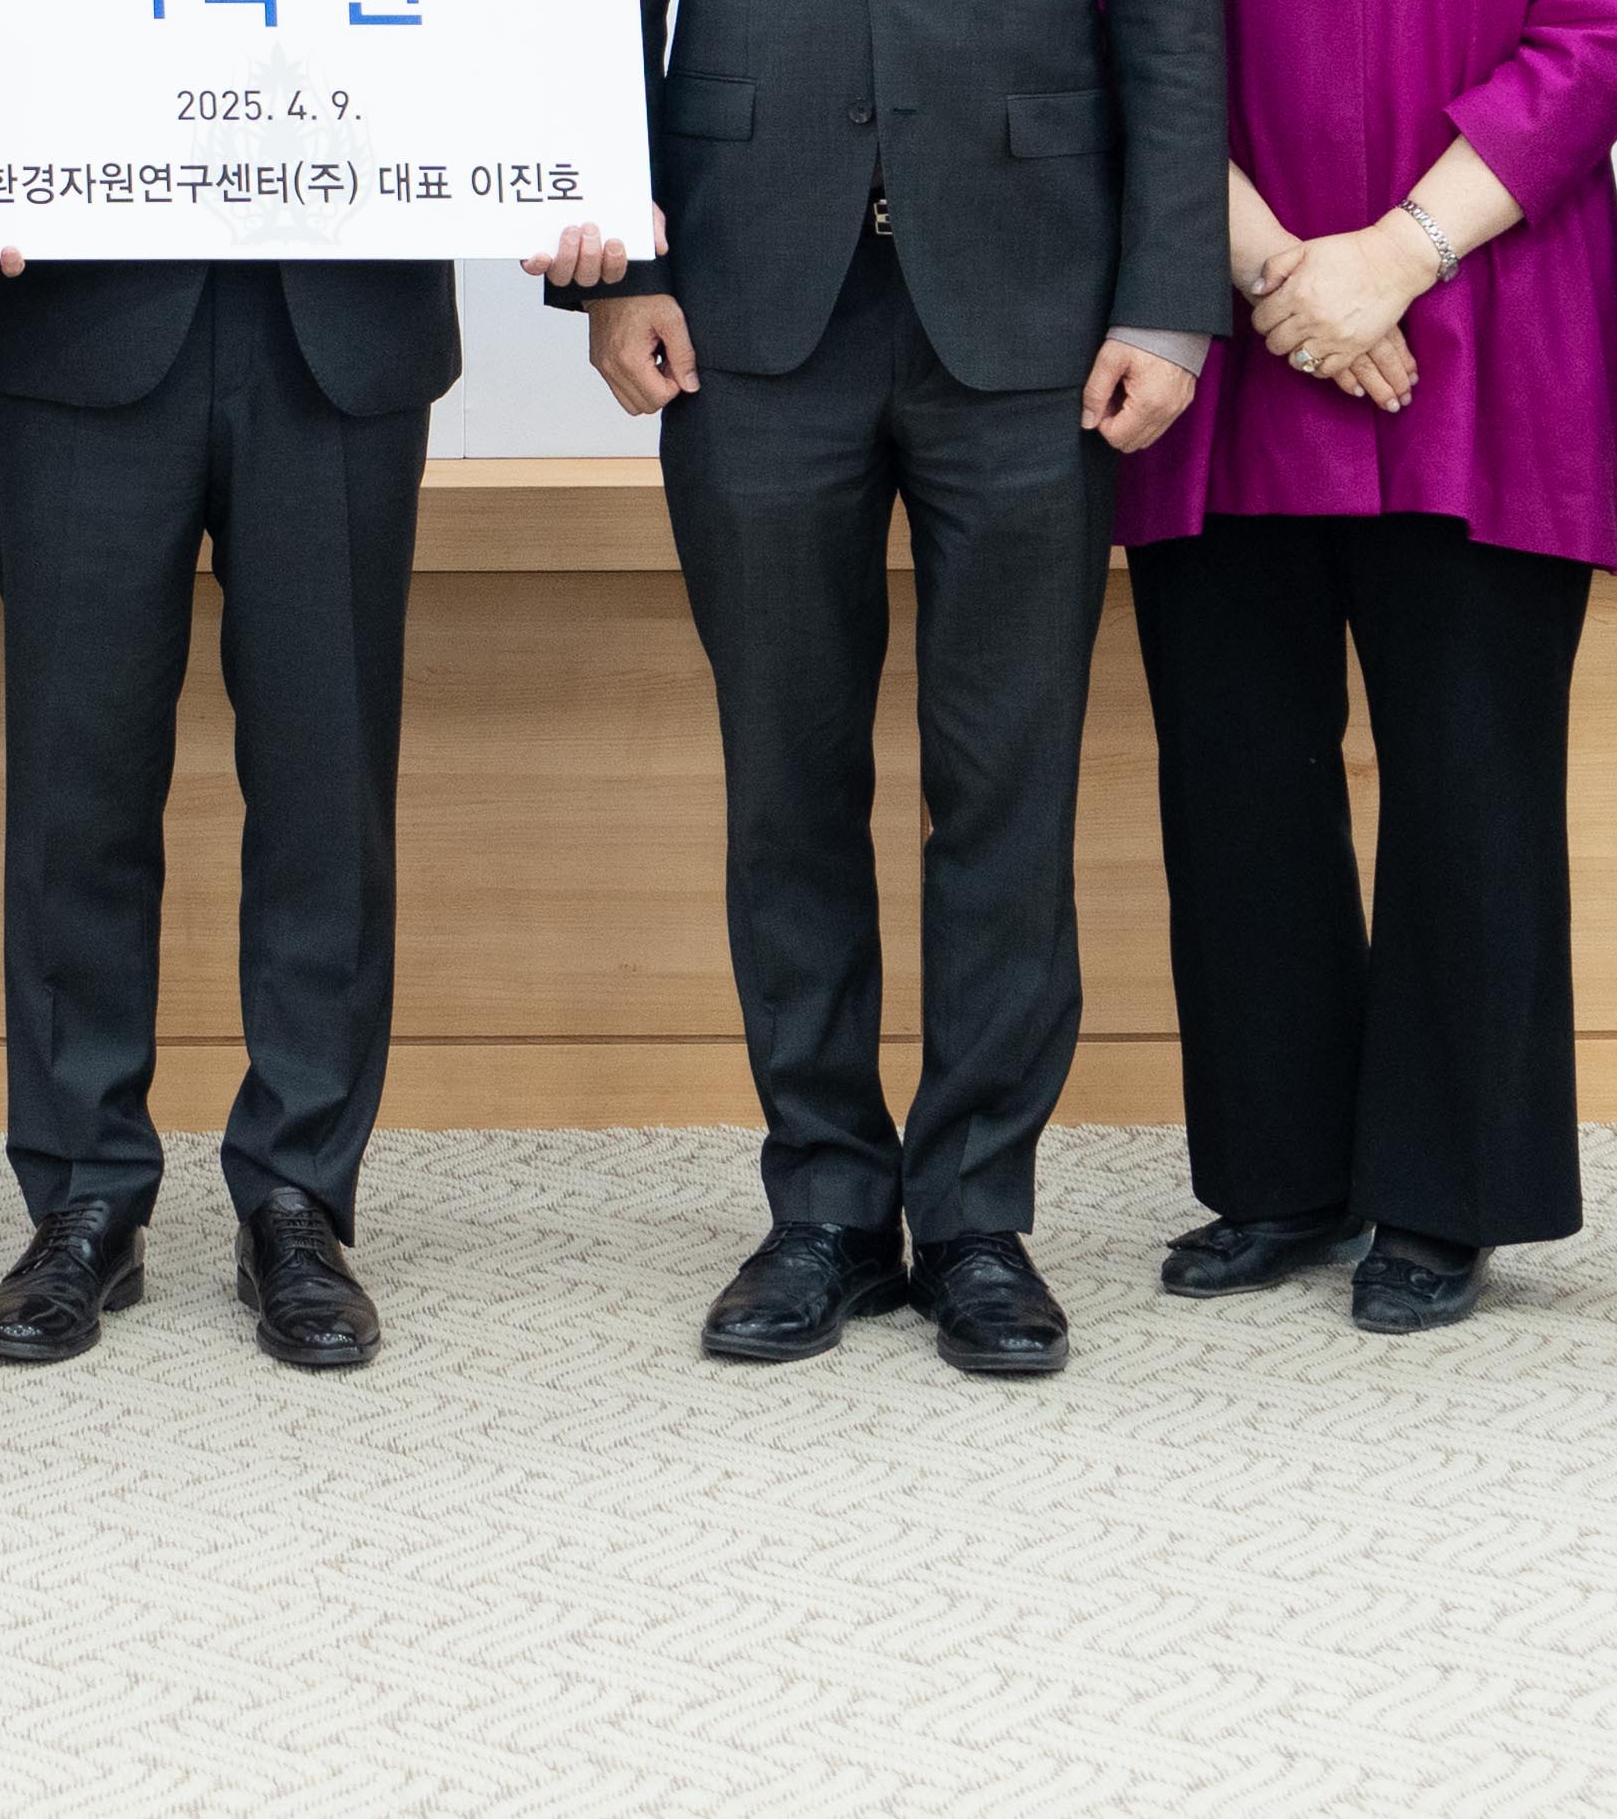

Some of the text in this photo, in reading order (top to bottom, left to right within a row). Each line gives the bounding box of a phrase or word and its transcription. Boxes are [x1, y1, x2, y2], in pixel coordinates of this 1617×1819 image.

[176, 90, 362, 122] 2025. 4. 9.
[378, 161, 453, 204] 대표
[470, 161, 585, 205] 이진호
